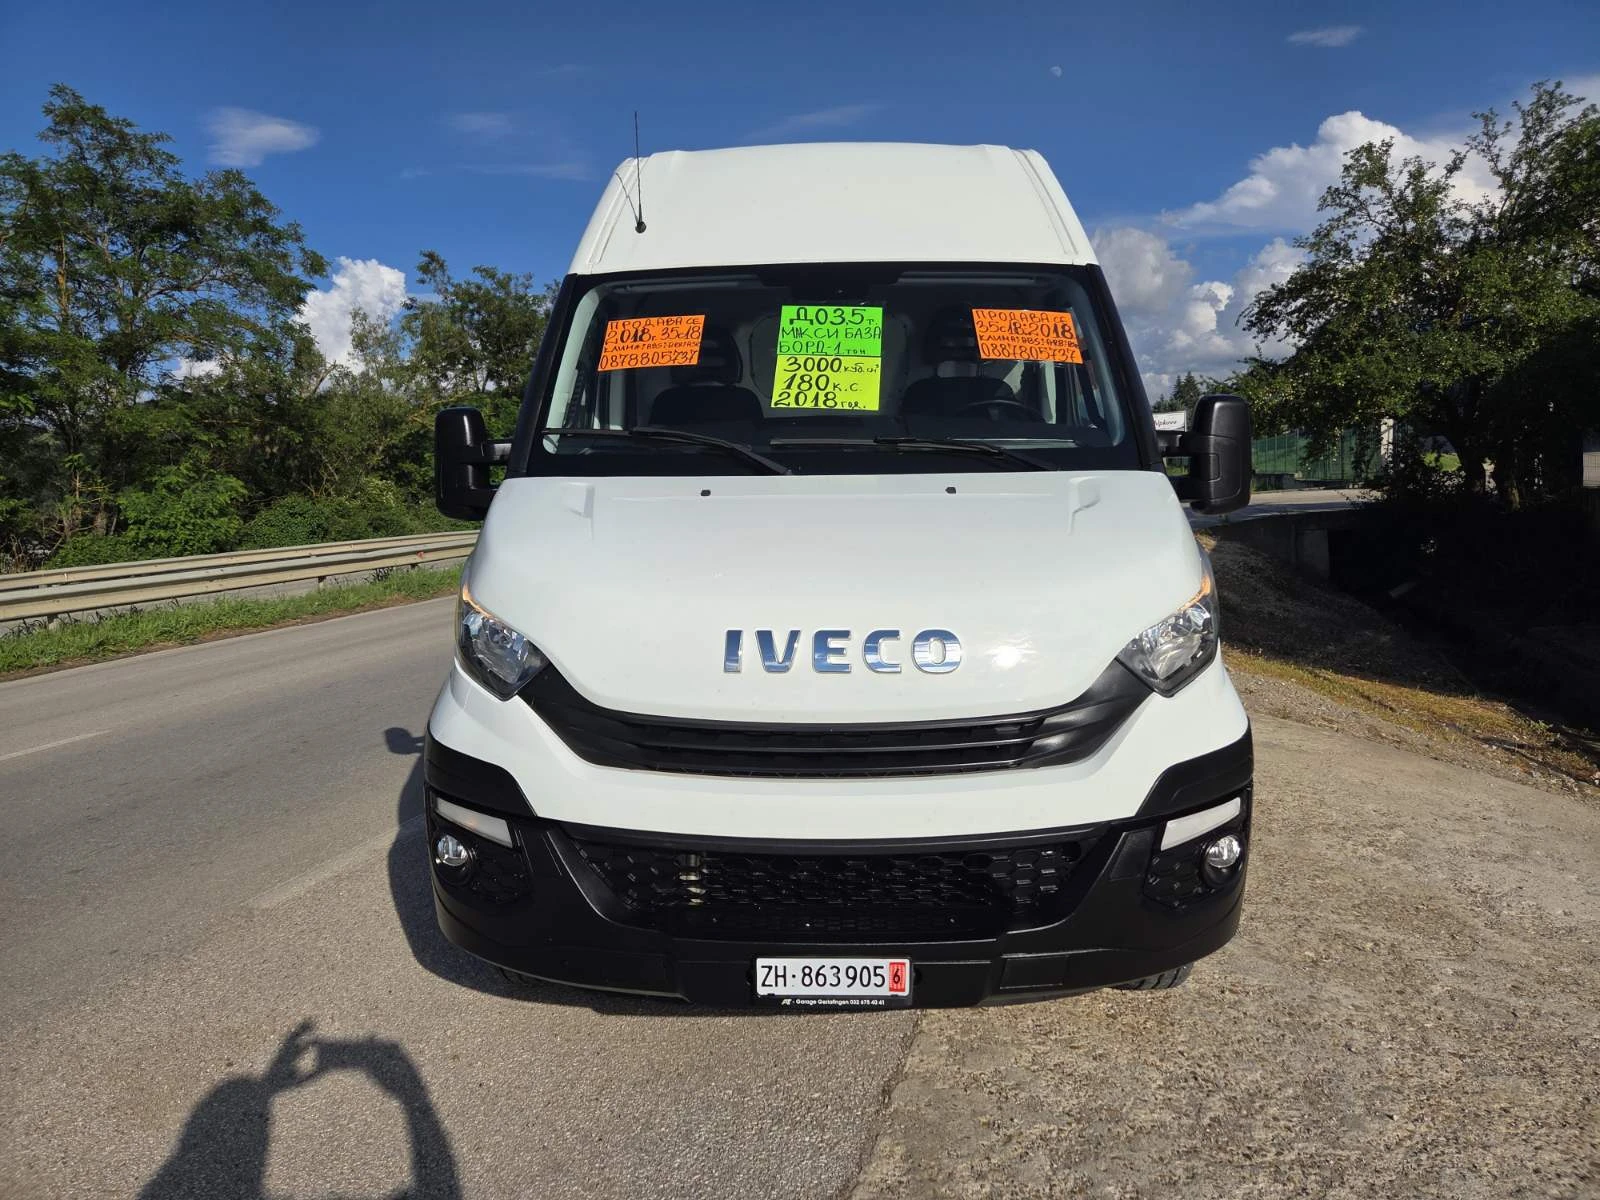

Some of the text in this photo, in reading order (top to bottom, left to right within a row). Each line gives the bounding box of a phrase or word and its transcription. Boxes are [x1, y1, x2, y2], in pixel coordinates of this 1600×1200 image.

[844, 326, 881, 339] БАЗА
[723, 629, 962, 674] IVECO
[795, 998, 817, 1006] Garage
